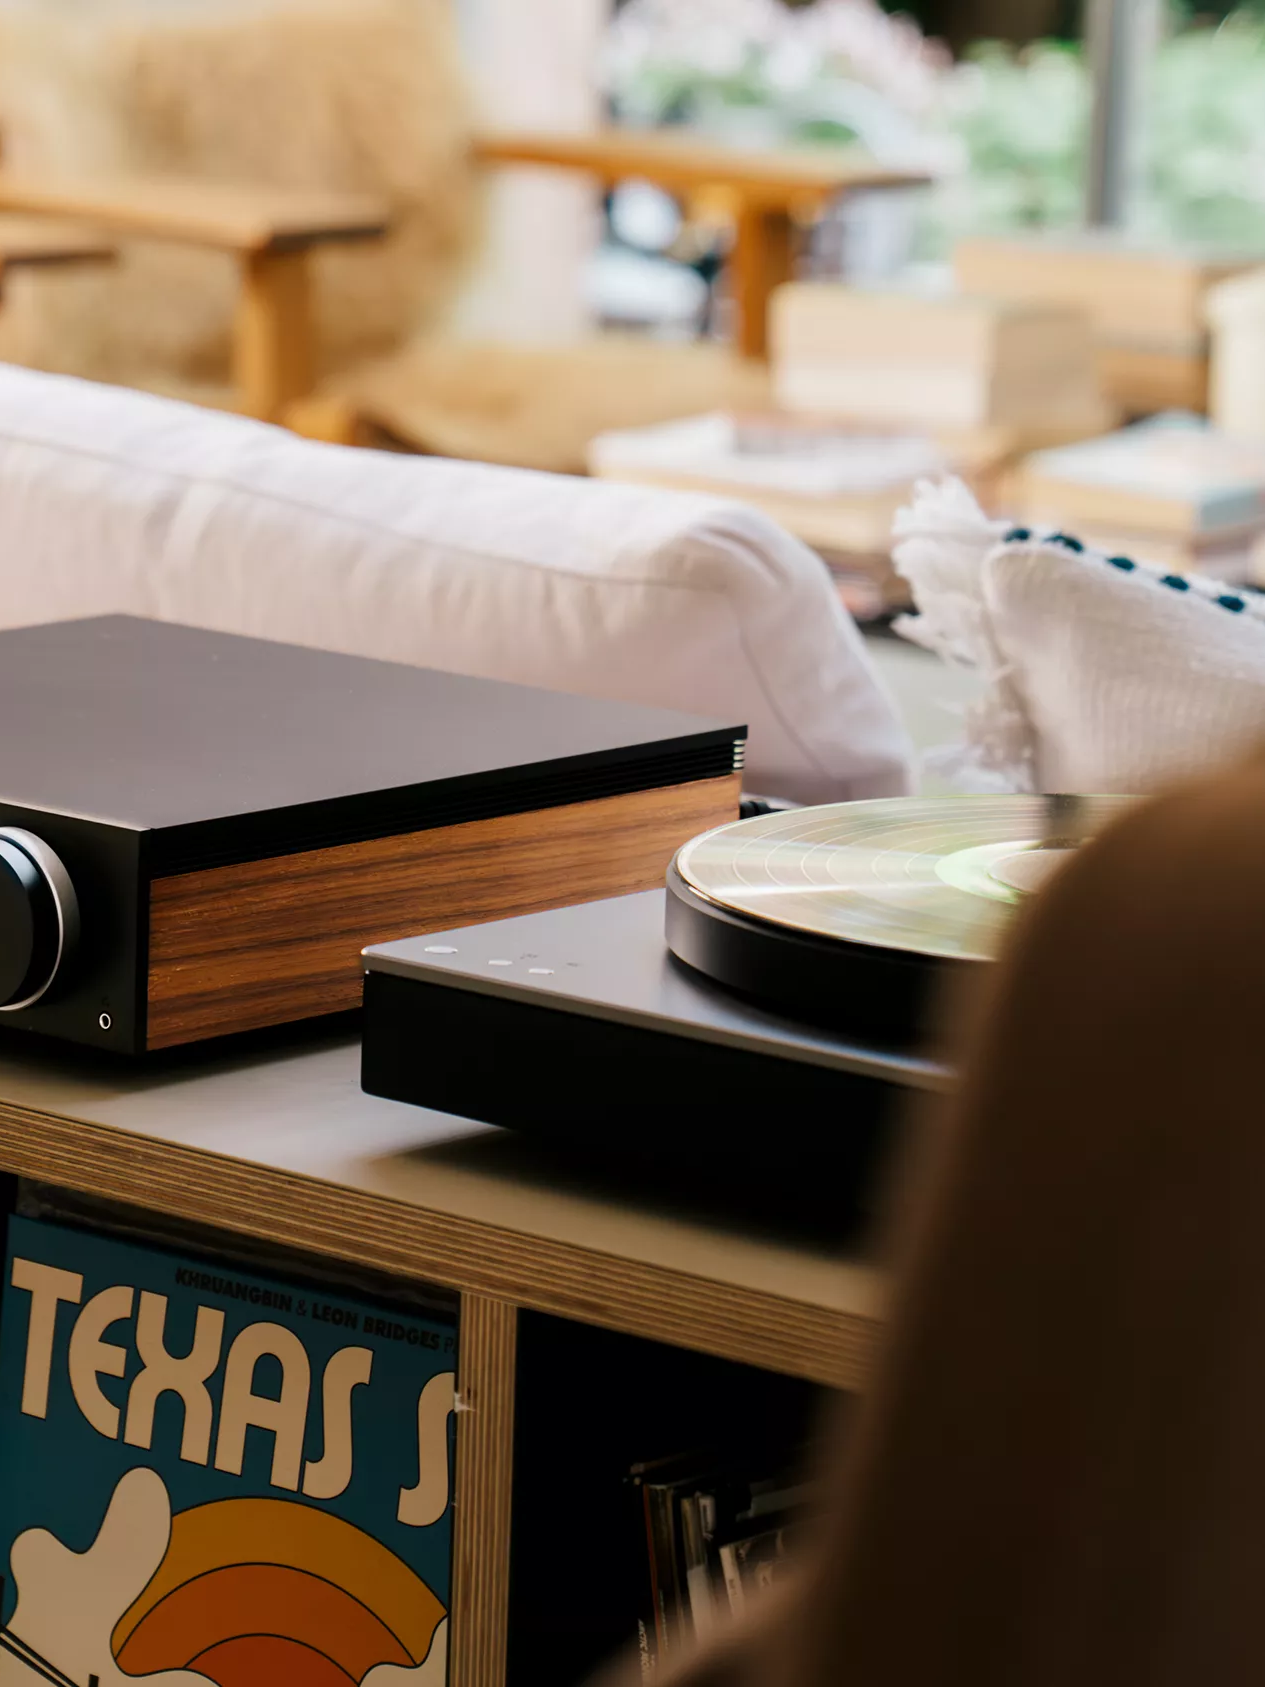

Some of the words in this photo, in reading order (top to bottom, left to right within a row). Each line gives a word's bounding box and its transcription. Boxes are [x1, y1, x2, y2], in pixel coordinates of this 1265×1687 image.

[10, 1255, 375, 1501] TEXAS
[175, 1266, 292, 1314] KHRUANGBIN
[295, 1301, 308, 1317] &
[312, 1302, 360, 1330] LEON
[362, 1316, 441, 1351] BRIDGES
